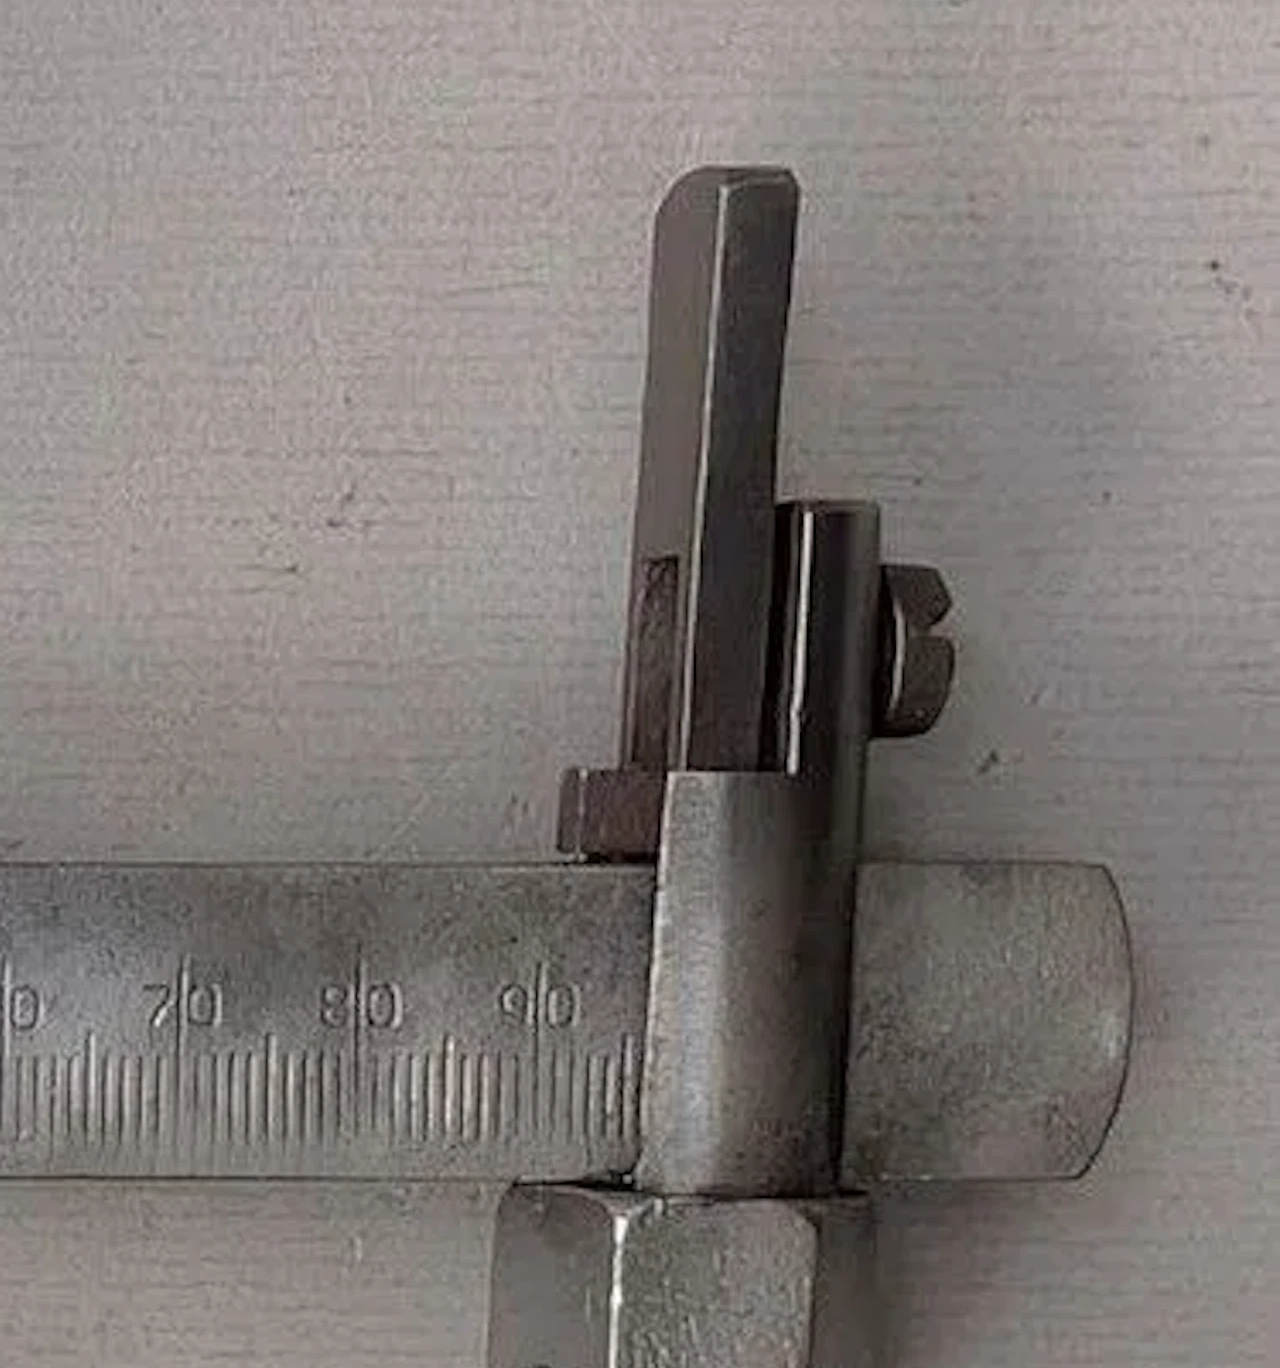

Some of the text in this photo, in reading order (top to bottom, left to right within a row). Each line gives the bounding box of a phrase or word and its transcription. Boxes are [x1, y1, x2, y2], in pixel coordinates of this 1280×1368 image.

[142, 983, 222, 1031] 70
[321, 983, 400, 1029] 80
[500, 983, 578, 1028] 90
